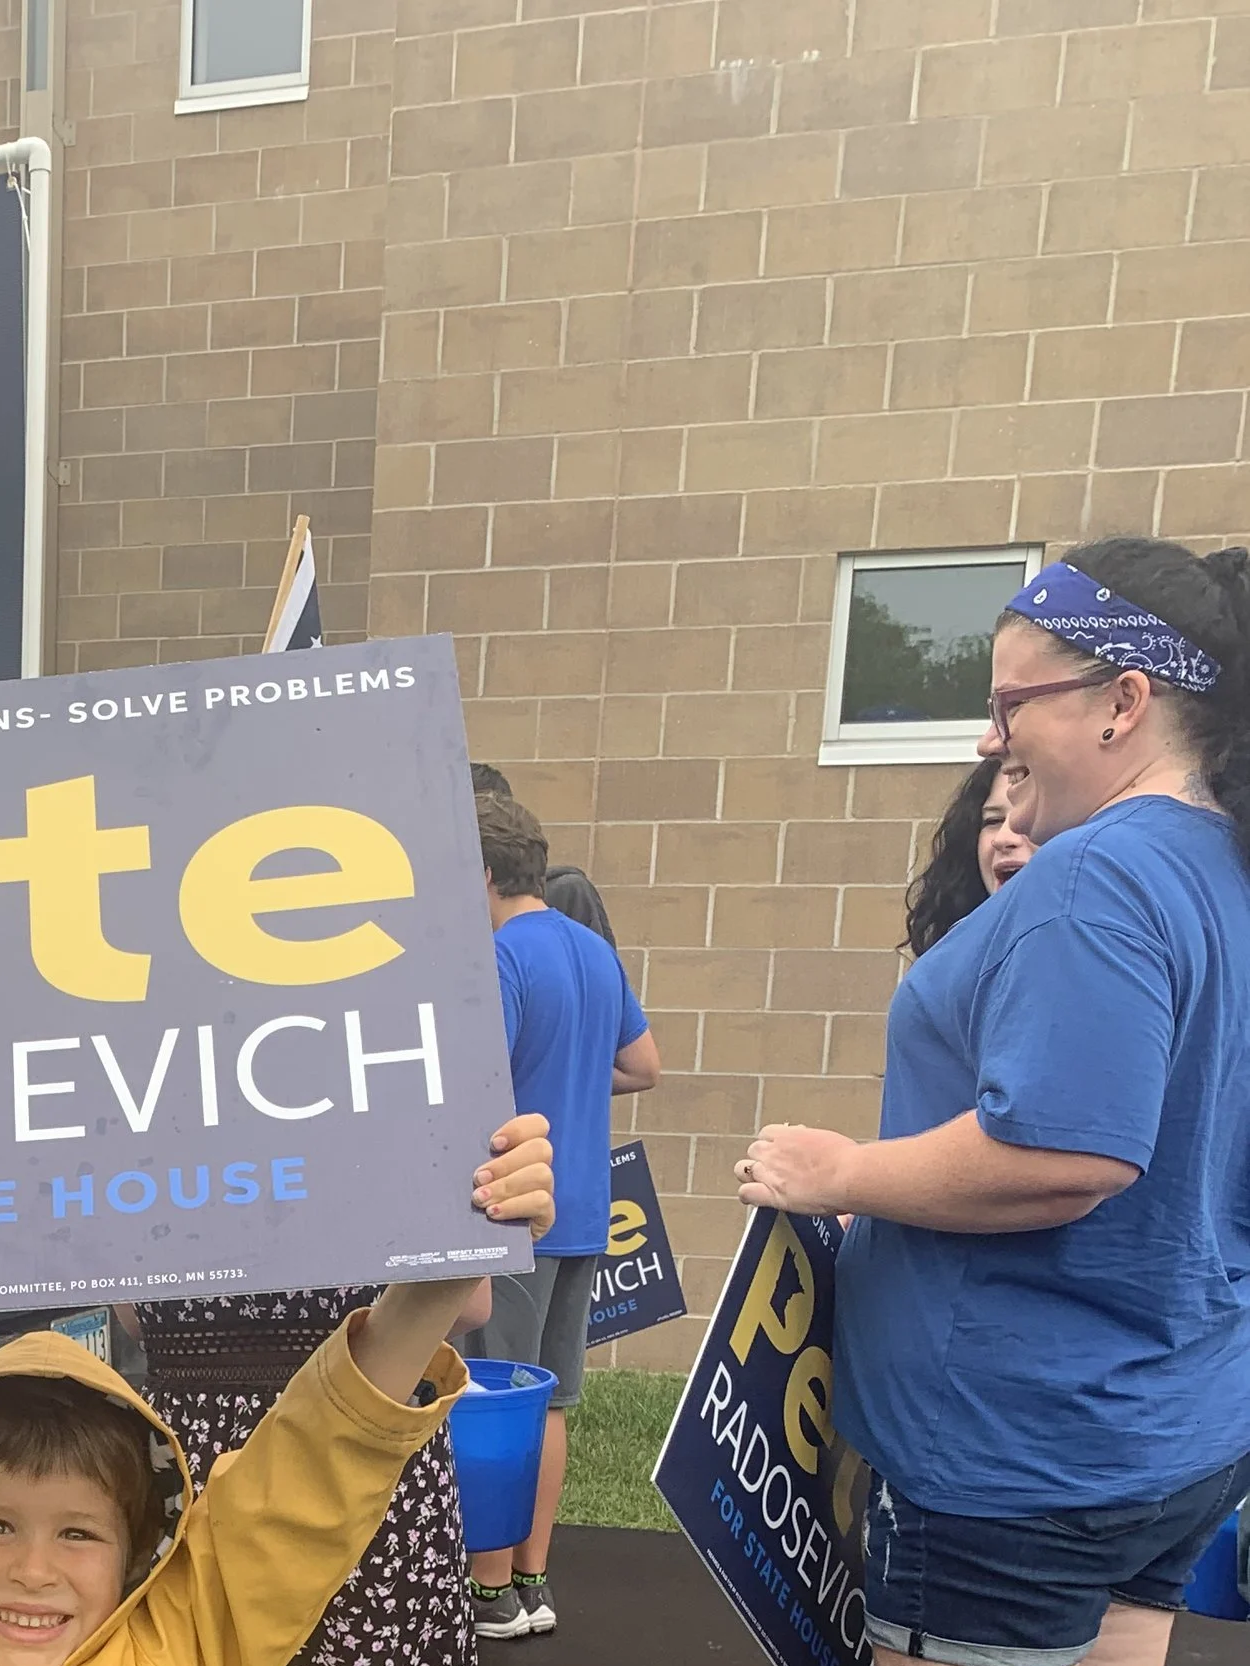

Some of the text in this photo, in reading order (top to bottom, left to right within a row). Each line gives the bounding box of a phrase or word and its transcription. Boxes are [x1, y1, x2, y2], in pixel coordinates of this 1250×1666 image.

[68, 690, 189, 724] SOLVE
[205, 665, 417, 711] PROBLEMS
[51, 1156, 309, 1219] HOUSE
[70, 1280, 87, 1290] PO
[91, 1278, 116, 1289] BOX
[119, 1276, 143, 1287] 411,
[147, 1273, 182, 1285] ESKO,
[186, 1271, 205, 1282] MN
[209, 1268, 248, 1281] 55733.
[710, 1478, 744, 1540] FOR
[743, 1531, 791, 1610] STATE
